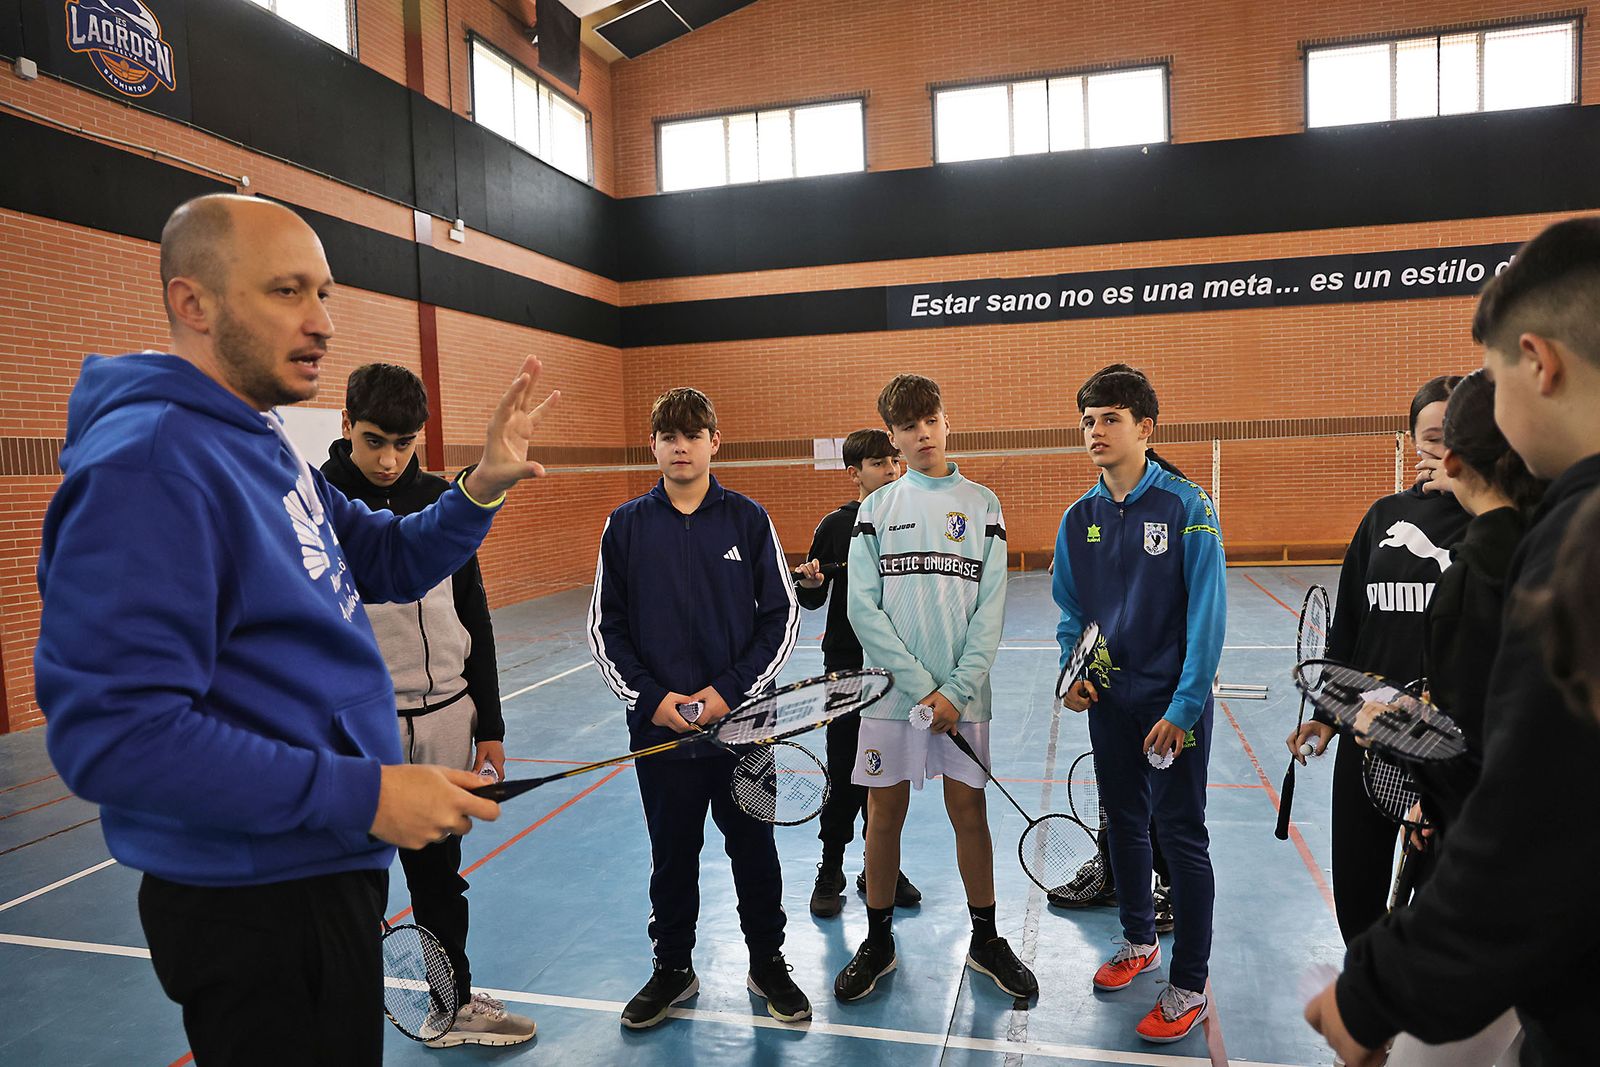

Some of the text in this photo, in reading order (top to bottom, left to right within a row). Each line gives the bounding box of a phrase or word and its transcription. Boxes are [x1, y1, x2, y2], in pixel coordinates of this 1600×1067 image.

[70, 5, 172, 83] LAORDEN
[103, 68, 147, 92] BADMINTON
[911, 293, 981, 317] Estar
[985, 291, 1051, 312] sano
[1059, 288, 1093, 307] no
[1102, 285, 1134, 305] es
[1142, 282, 1194, 303] una
[1202, 273, 1300, 299] meta...
[1310, 272, 1344, 292] es
[1353, 269, 1392, 290] un
[1400, 258, 1485, 286] estilo
[879, 555, 979, 579] TLETIC ONUBENSE
